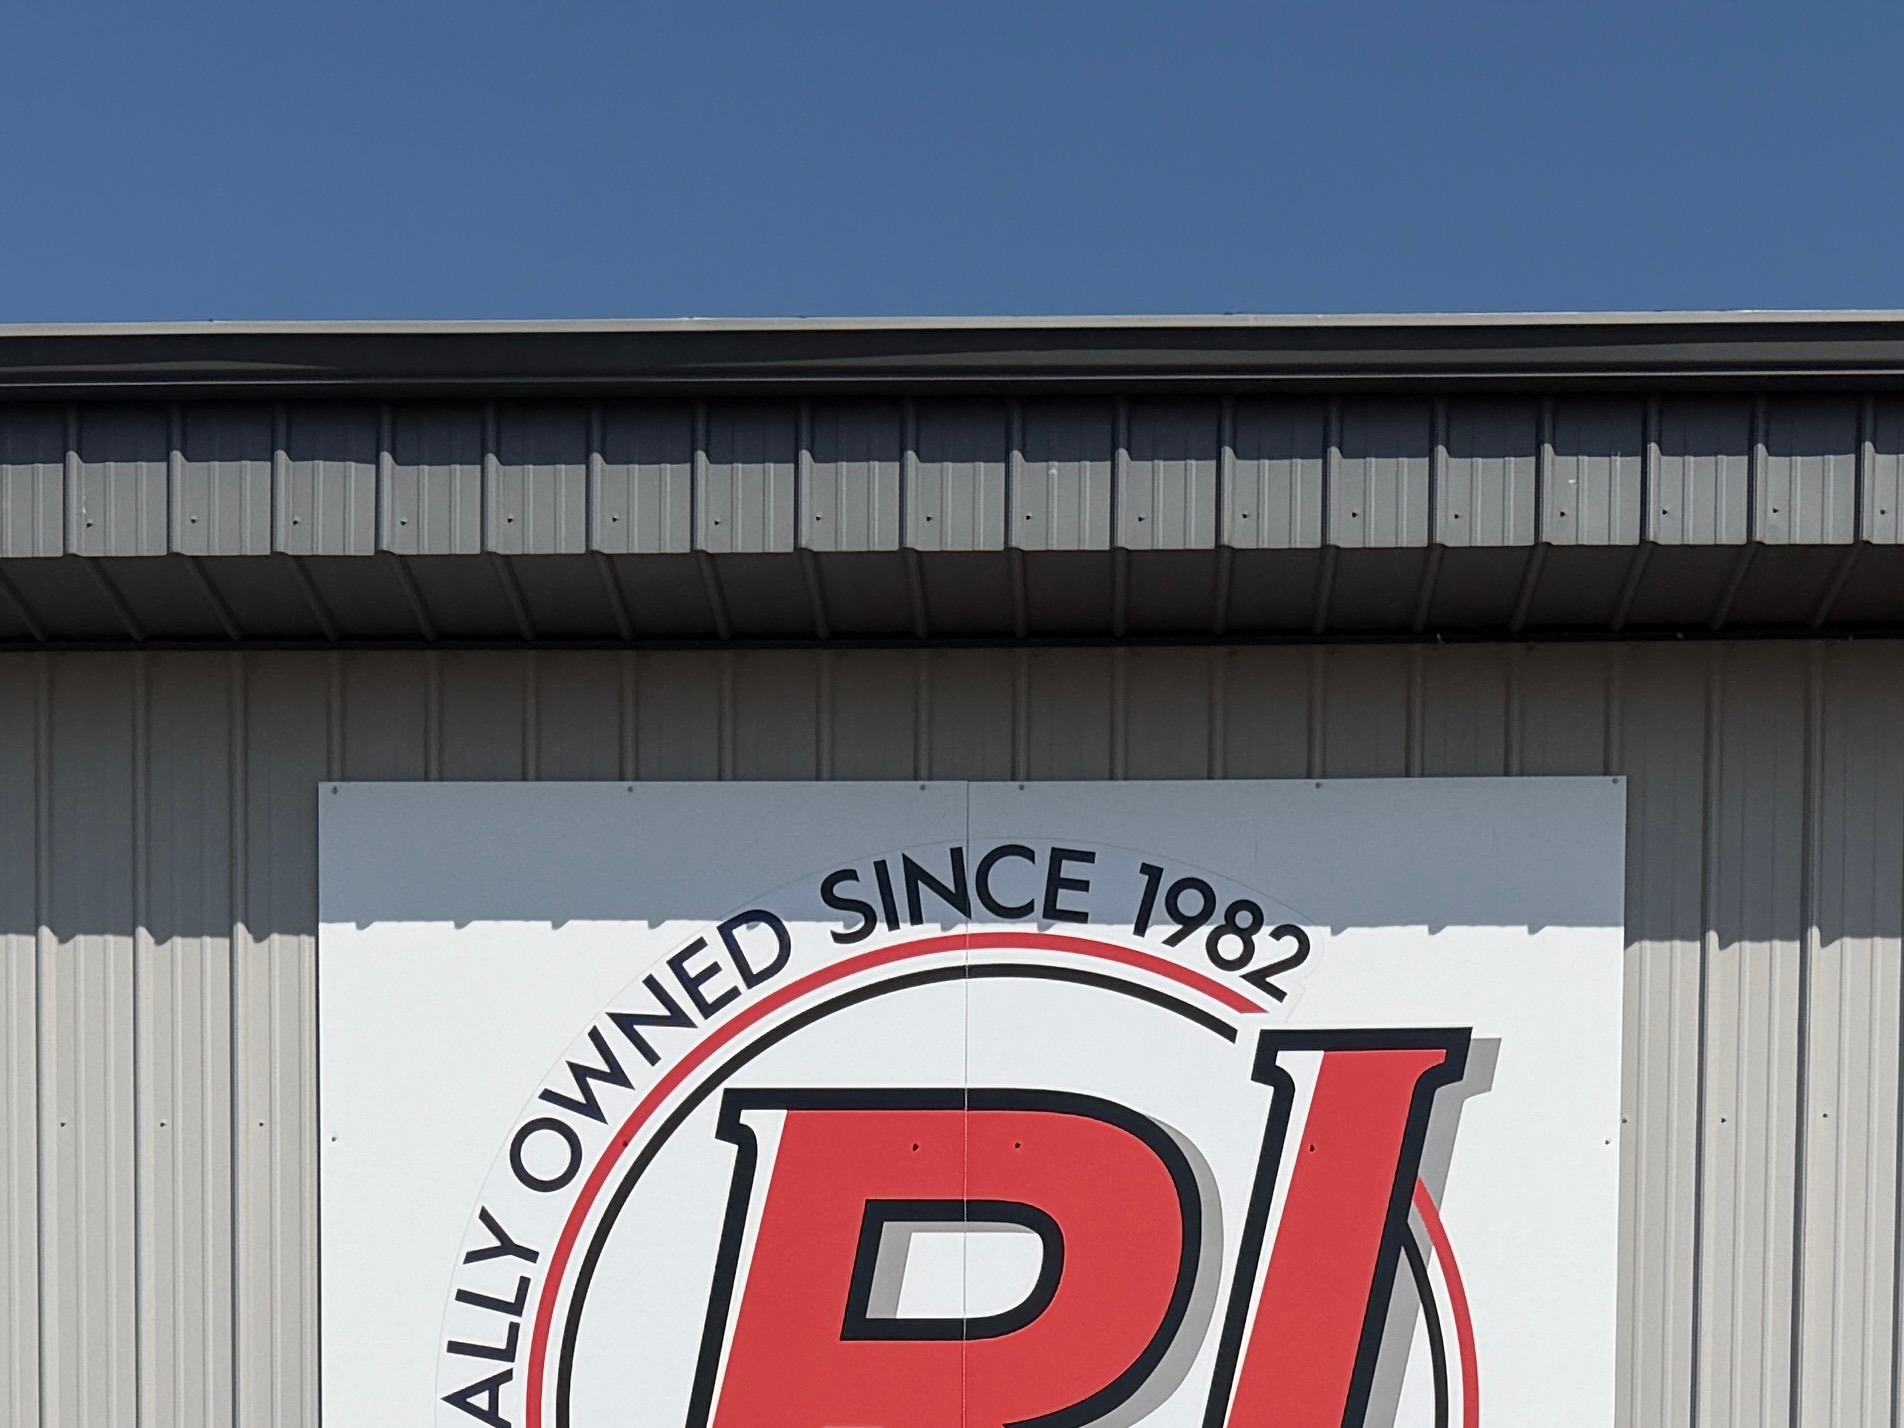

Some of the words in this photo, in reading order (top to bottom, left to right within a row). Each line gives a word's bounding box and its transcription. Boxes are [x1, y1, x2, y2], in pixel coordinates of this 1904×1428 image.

[509, 909, 793, 1193] OWNED
[820, 843, 1098, 945] SINCE
[1132, 861, 1312, 1003] 1982
